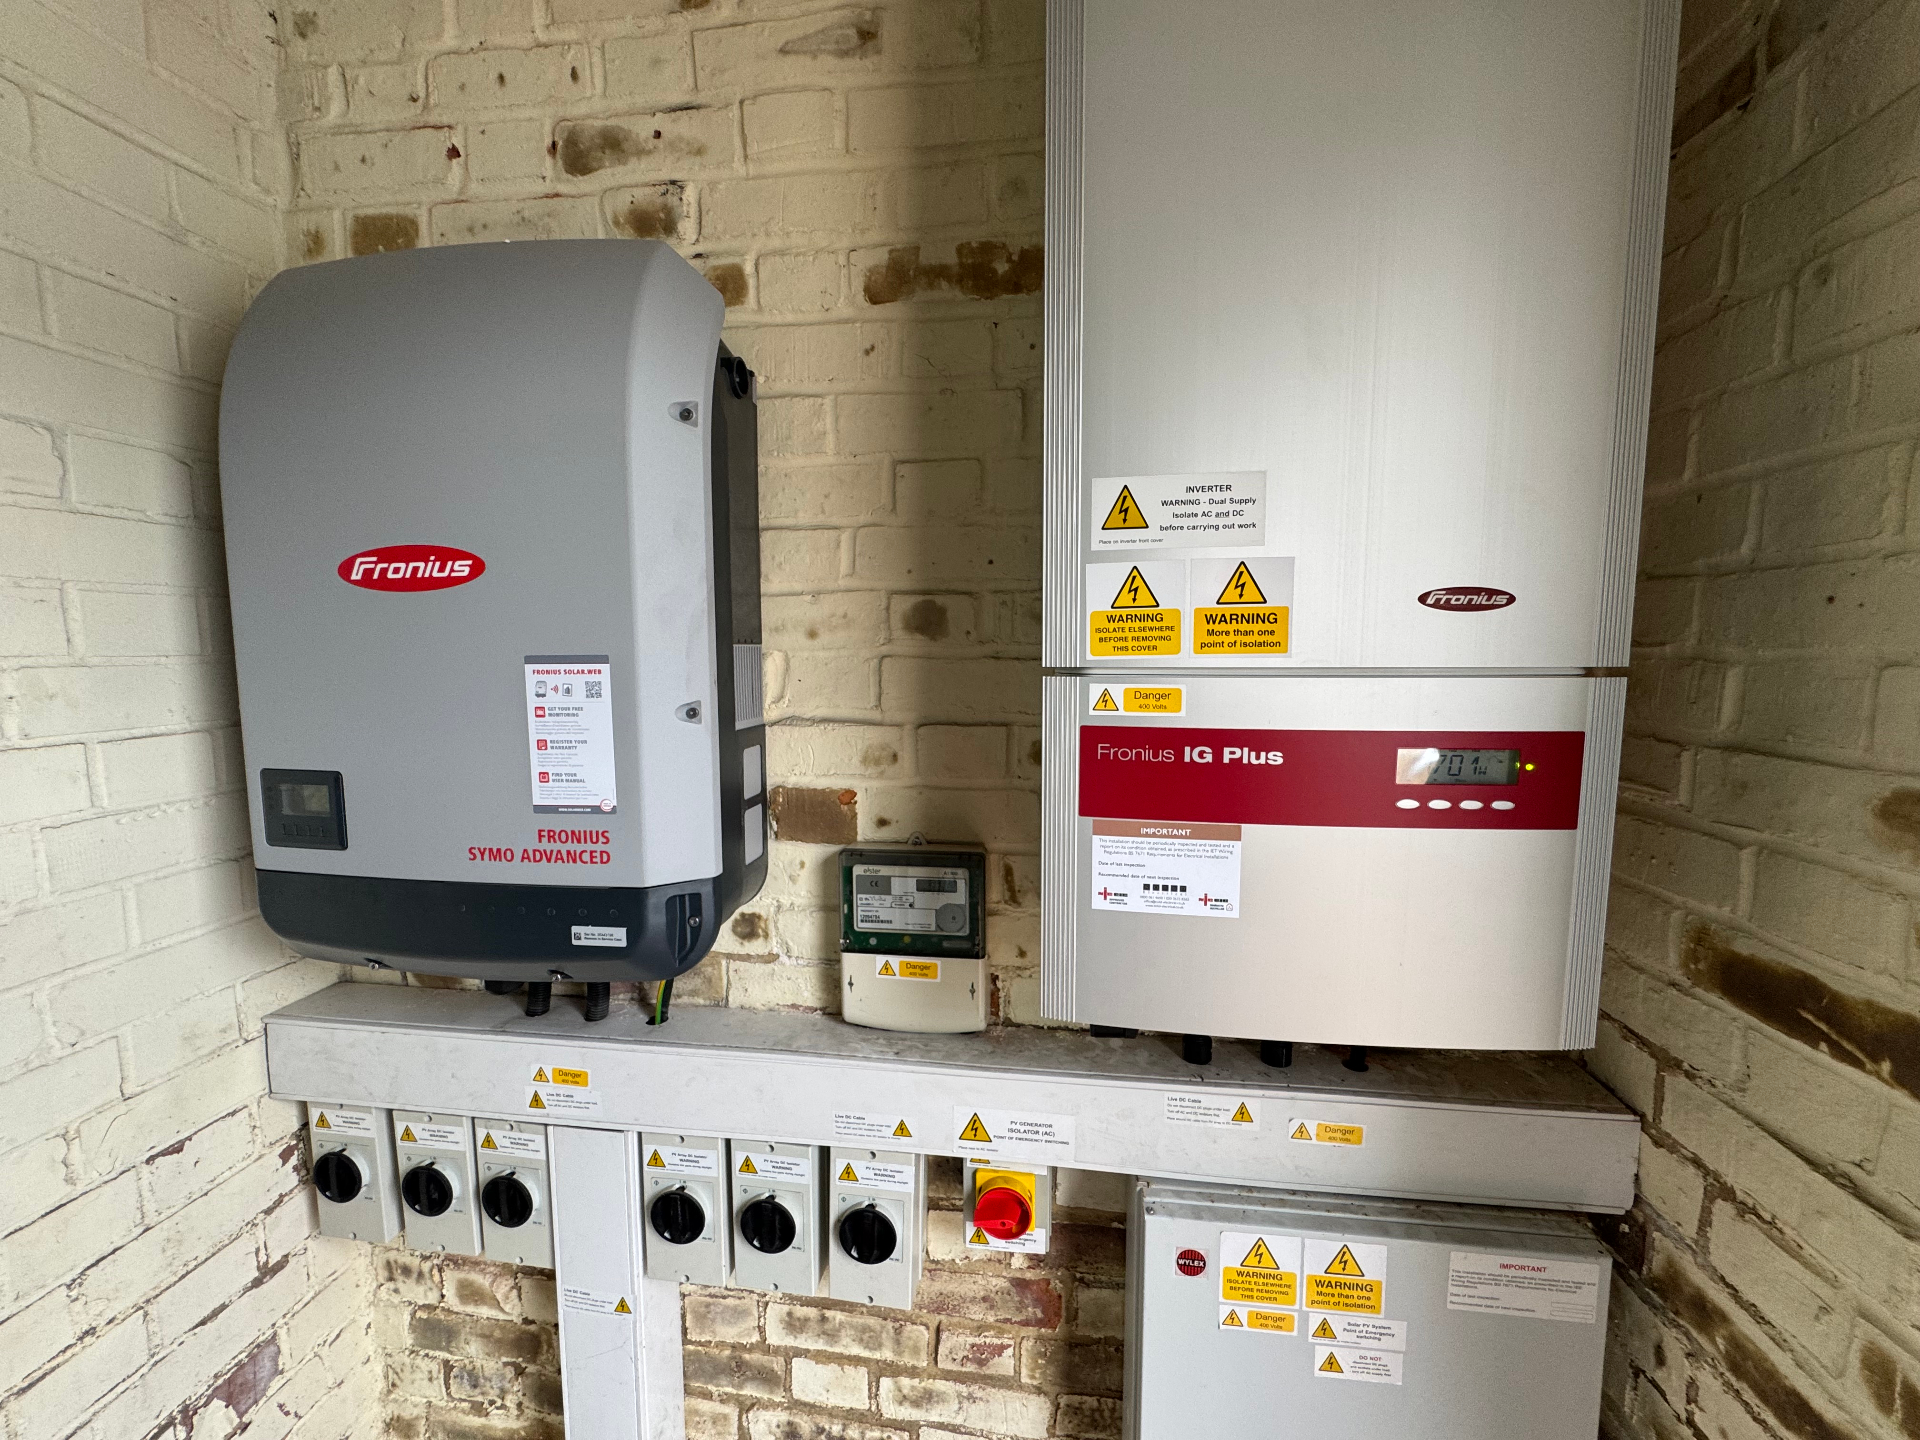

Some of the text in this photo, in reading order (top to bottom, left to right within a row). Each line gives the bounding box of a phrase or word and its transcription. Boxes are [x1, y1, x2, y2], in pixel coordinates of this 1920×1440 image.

[1186, 484, 1232, 493] INVERTER
[1230, 498, 1256, 507] Supply
[1187, 523, 1219, 532] carrying
[351, 556, 472, 580] Fronius
[1426, 590, 1510, 605] Fronius
[1107, 614, 1163, 624] WARNING
[1205, 613, 1277, 624] WARNING
[1200, 641, 1224, 650] point
[1134, 691, 1171, 702] Danger
[1098, 744, 1283, 765] Fronius IG Plus
[537, 830, 610, 844] FRONIUS
[1141, 828, 1191, 836] IMPORTANT
[468, 847, 610, 864] SYMO ADVANCED
[906, 963, 931, 971] Danger
[559, 1070, 582, 1079] Danger
[1325, 1126, 1355, 1135] Danger
[1178, 1259, 1204, 1267] WYLEX
[1500, 1263, 1546, 1273] IMPORTANT
[1236, 1270, 1282, 1281] WARNING
[1315, 1280, 1373, 1292] WARNING
[1343, 1302, 1375, 1310] isolation
[1256, 1313, 1286, 1323] Danger
